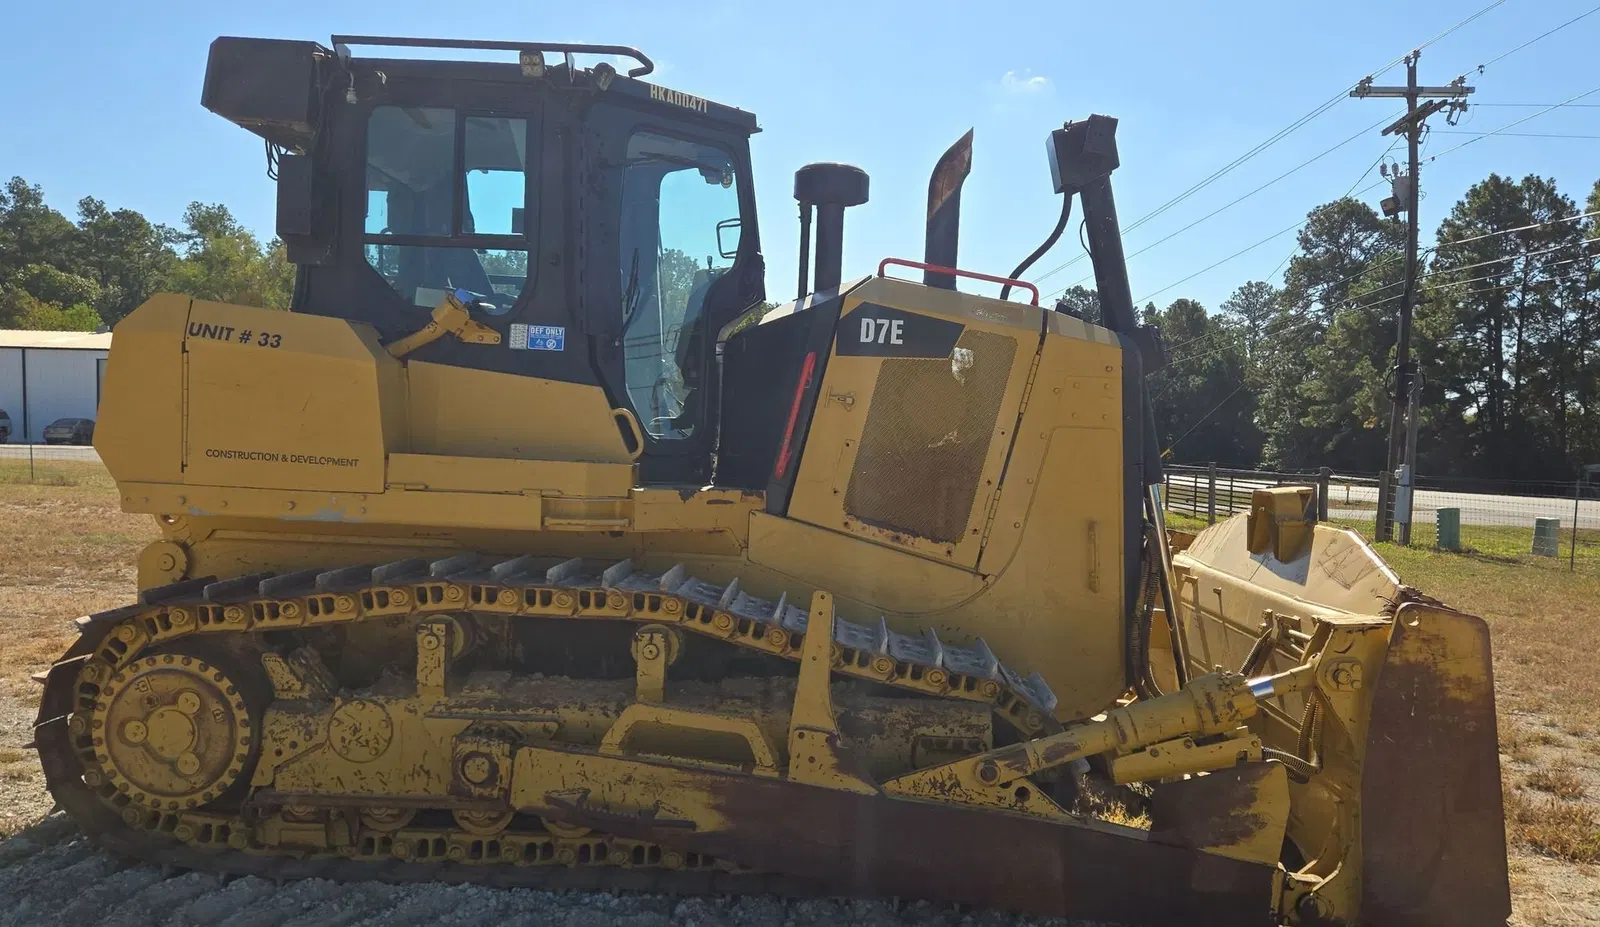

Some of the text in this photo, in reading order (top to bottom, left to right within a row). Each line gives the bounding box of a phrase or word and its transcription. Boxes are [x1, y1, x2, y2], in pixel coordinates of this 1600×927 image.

[650, 84, 708, 113] HKA00471
[188, 322, 282, 348] UNIT # 33
[530, 327, 563, 336] DEF ONLY
[860, 317, 904, 345] D7E
[205, 448, 359, 467] CONSTRUCTION & DEVELOPMENT
